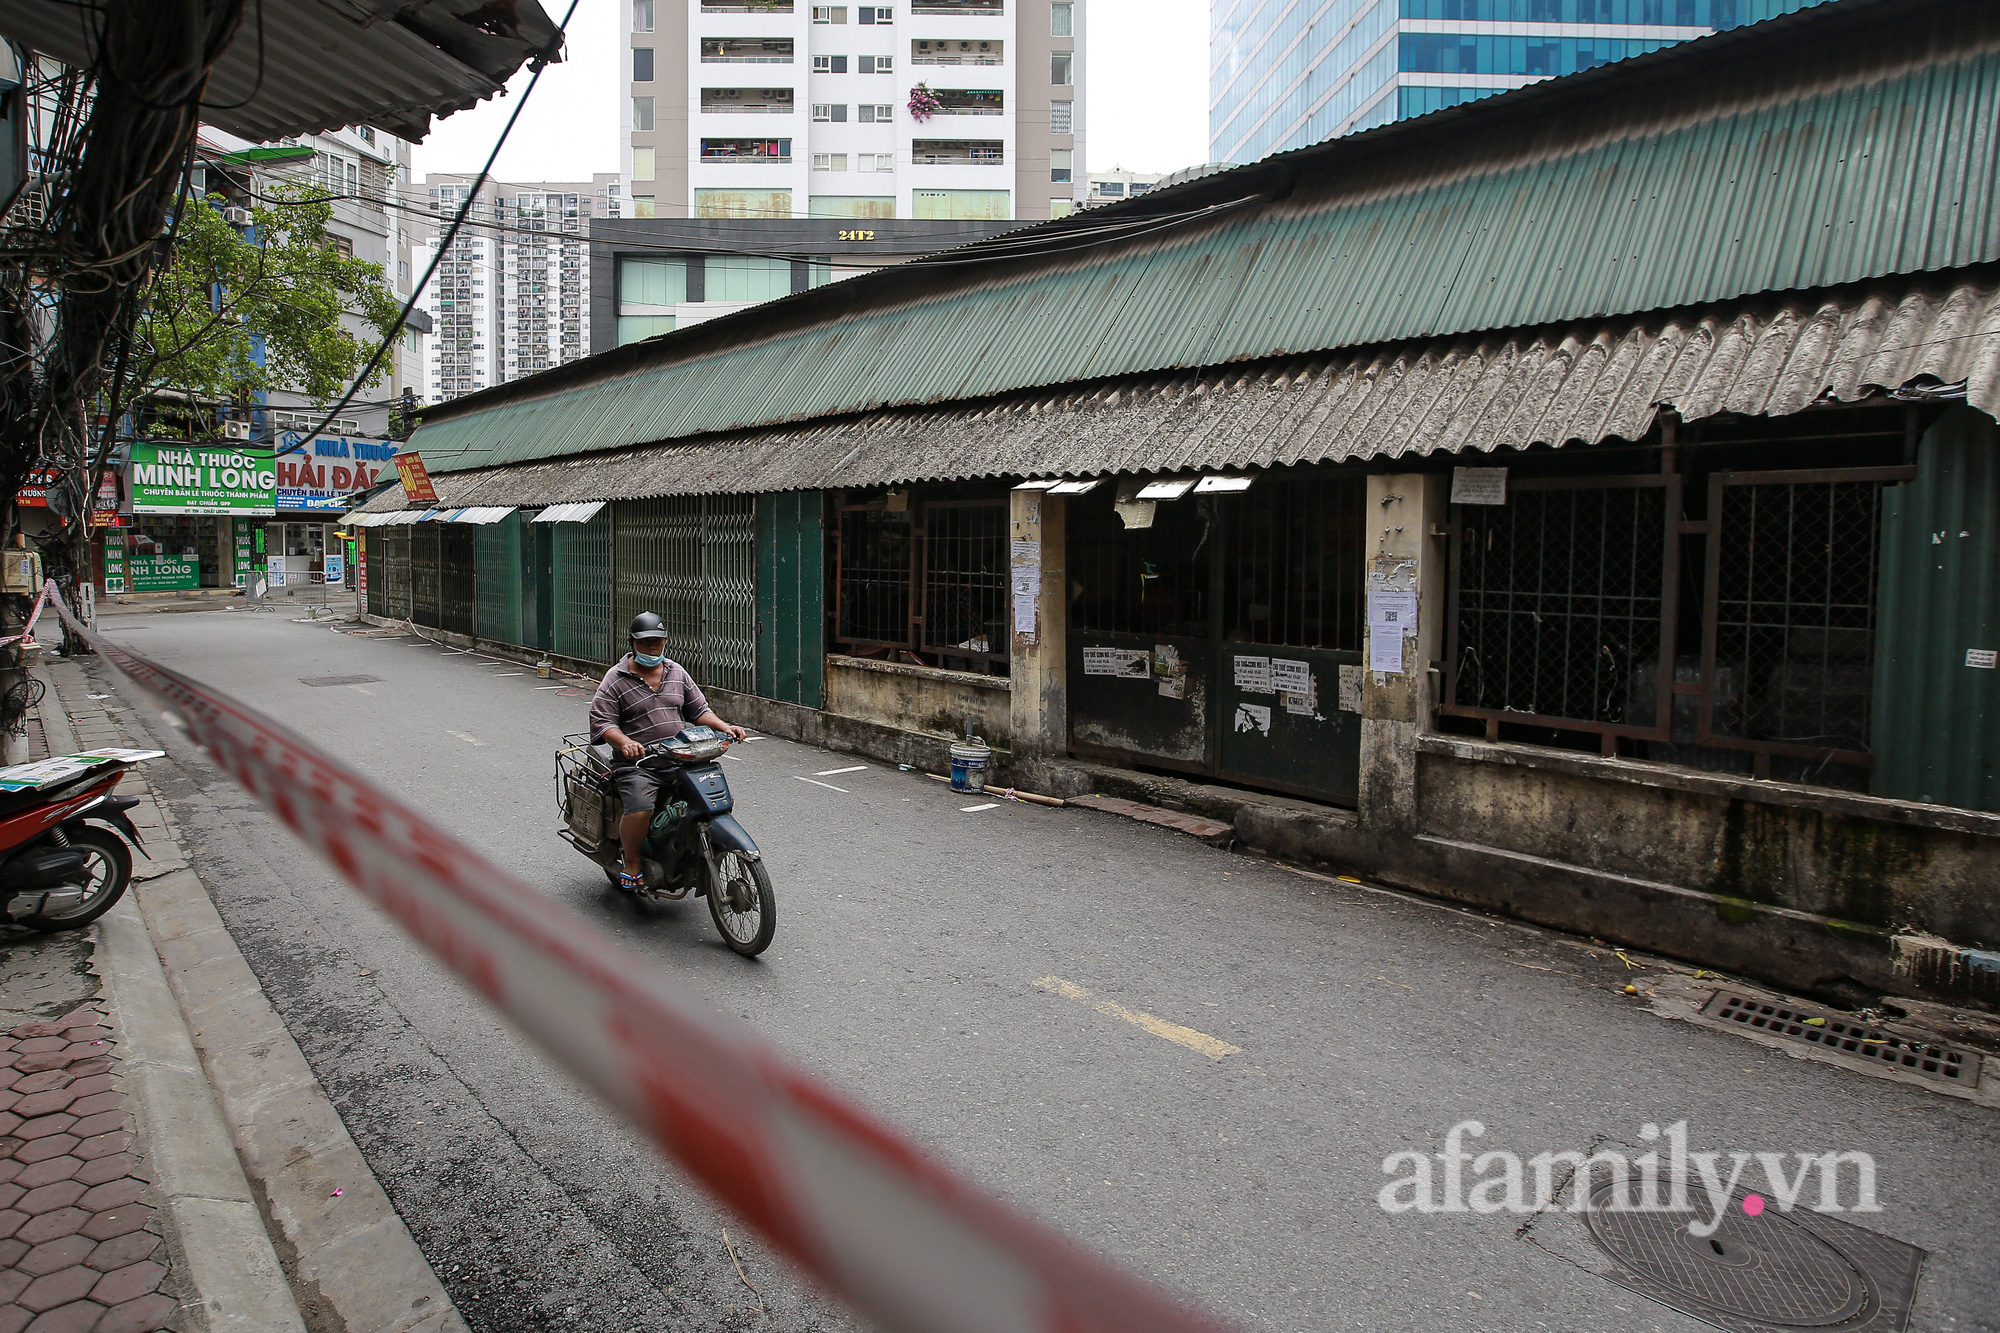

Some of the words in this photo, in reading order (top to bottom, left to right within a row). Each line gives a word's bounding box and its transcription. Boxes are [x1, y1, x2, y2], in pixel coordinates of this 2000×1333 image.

[839, 230, 875, 241] 24T2
[315, 437, 350, 458] NHÀ
[157, 448, 195, 466] NHÀ
[199, 449, 256, 470] THUỐC
[277, 453, 325, 488] HẢI
[133, 463, 201, 488] MINH
[209, 468, 275, 490] LONG
[143, 487, 176, 497] CHUYÊN
[200, 488, 225, 498] THUỐC
[226, 490, 249, 499] THÀNH
[249, 490, 269, 499] PHẨM
[276, 487, 307, 497] CHUYÊN
[237, 523, 248, 532] NHÀ
[106, 533, 123, 546] THUỐC
[236, 533, 251, 546] THUỐC
[107, 550, 122, 559] MINH
[237, 549, 250, 558] MINH
[130, 558, 148, 566] NHÀ
[237, 561, 250, 570] LONG
[108, 564, 122, 573] LONG
[155, 565, 191, 575] LONG
